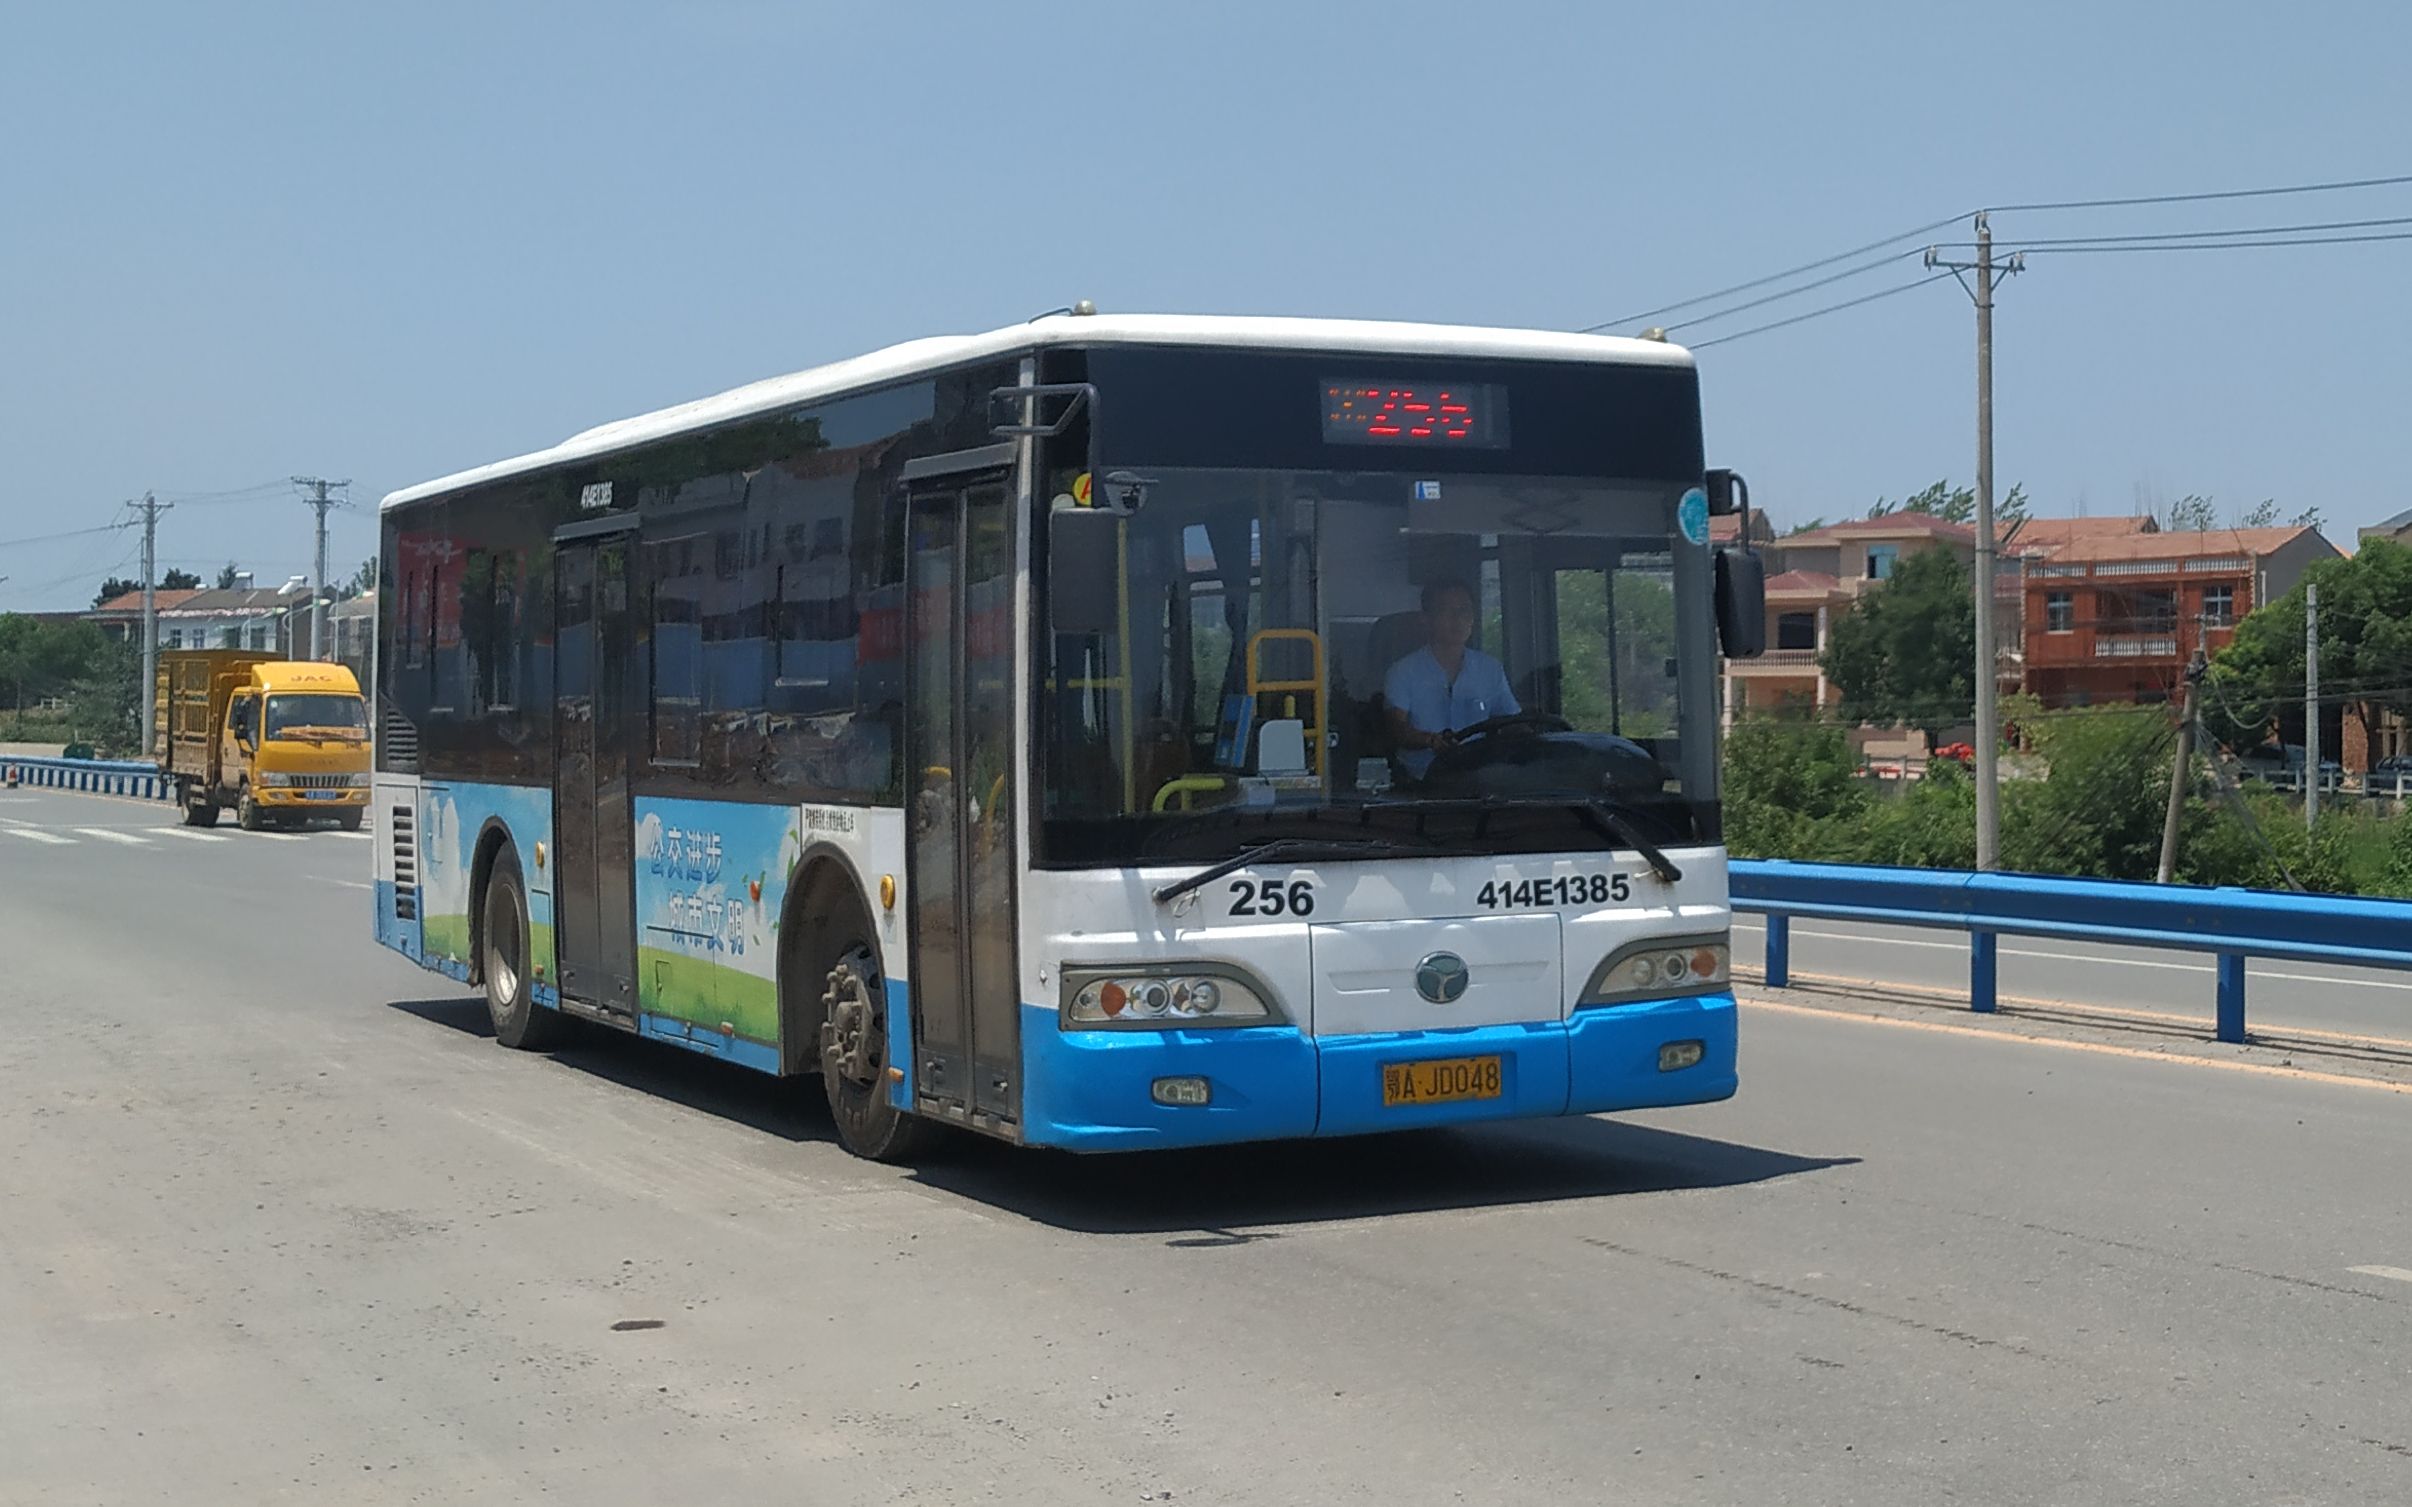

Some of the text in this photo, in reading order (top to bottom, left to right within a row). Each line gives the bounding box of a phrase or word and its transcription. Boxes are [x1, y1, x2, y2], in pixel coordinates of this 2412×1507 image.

[650, 822, 723, 884] 公交进步
[1228, 879, 1315, 917] 256
[1476, 872, 1631, 910] 414E1385
[669, 889, 745, 956] 城市文明
